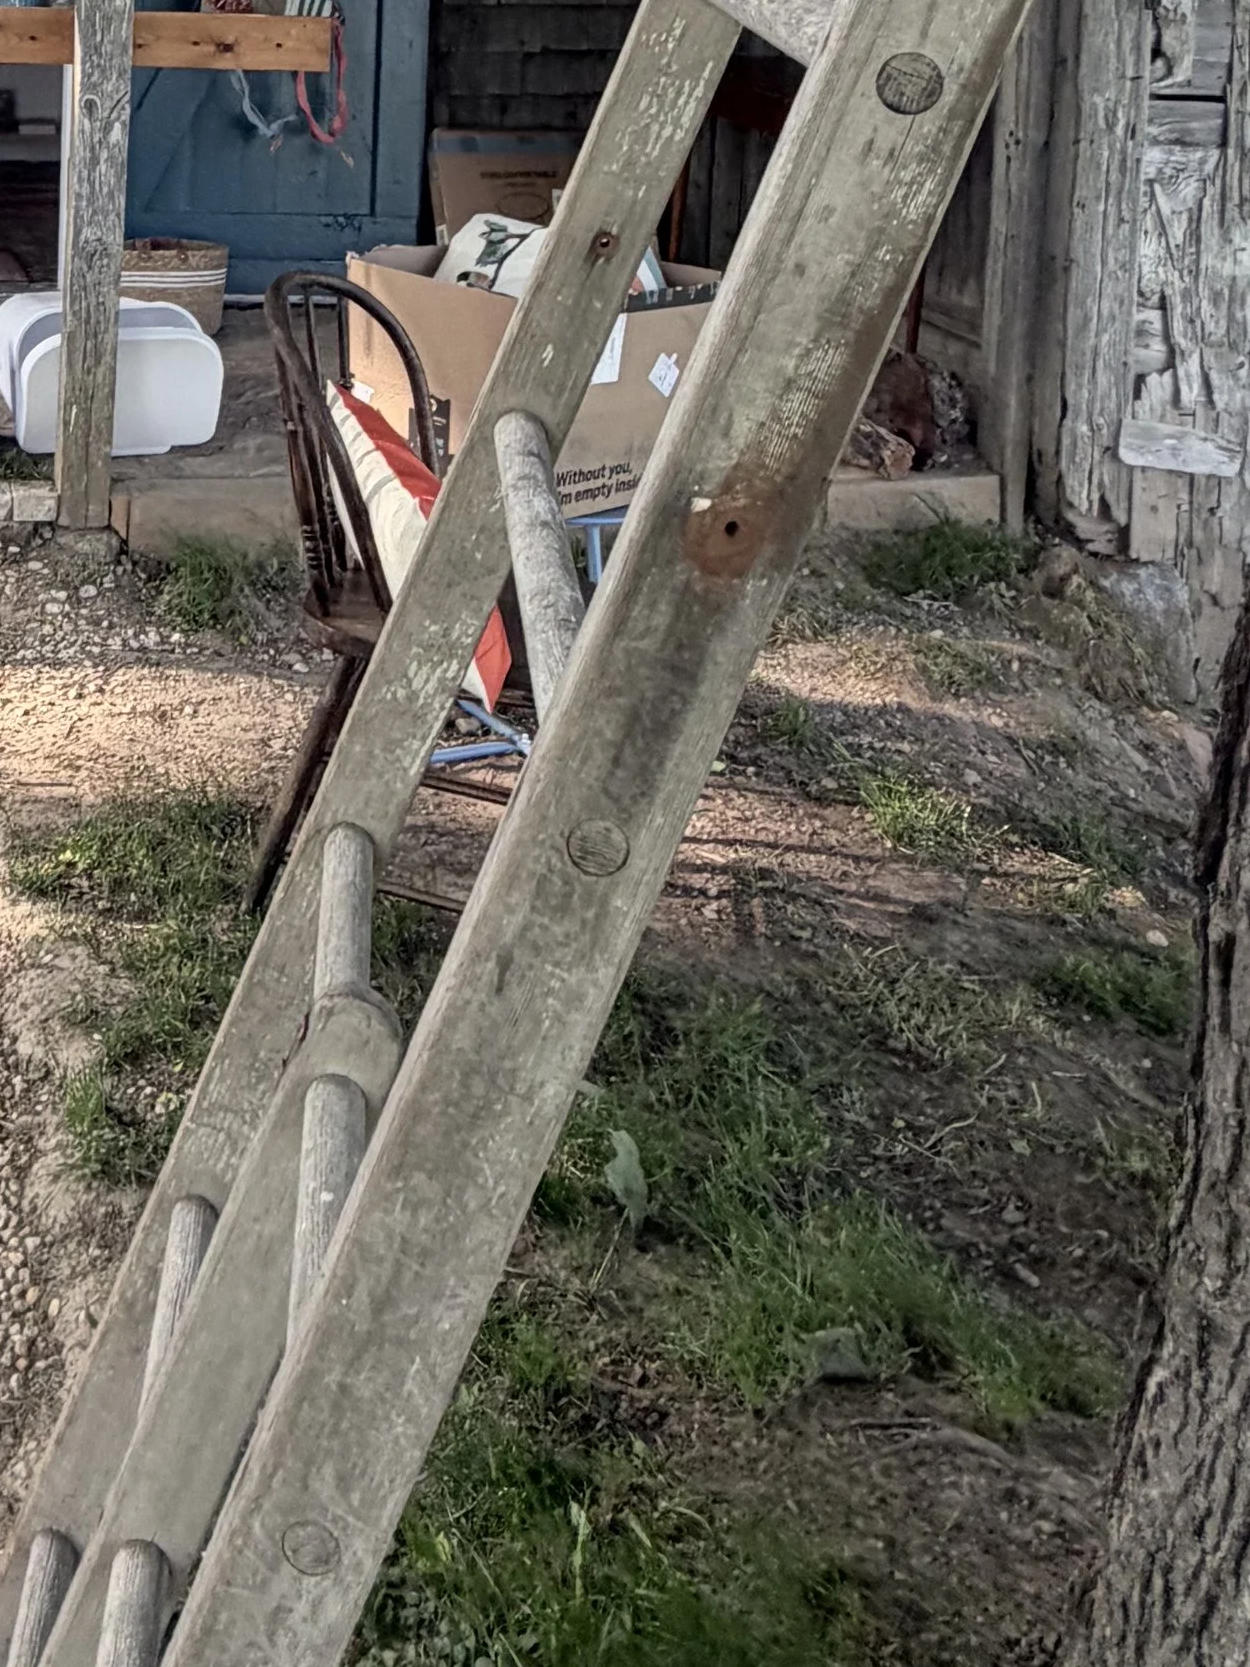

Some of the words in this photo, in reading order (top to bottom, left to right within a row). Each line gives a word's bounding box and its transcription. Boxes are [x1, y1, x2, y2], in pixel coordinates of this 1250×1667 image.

[556, 464, 607, 487] Without
[608, 462, 633, 480] you,
[574, 482, 614, 501] empty
